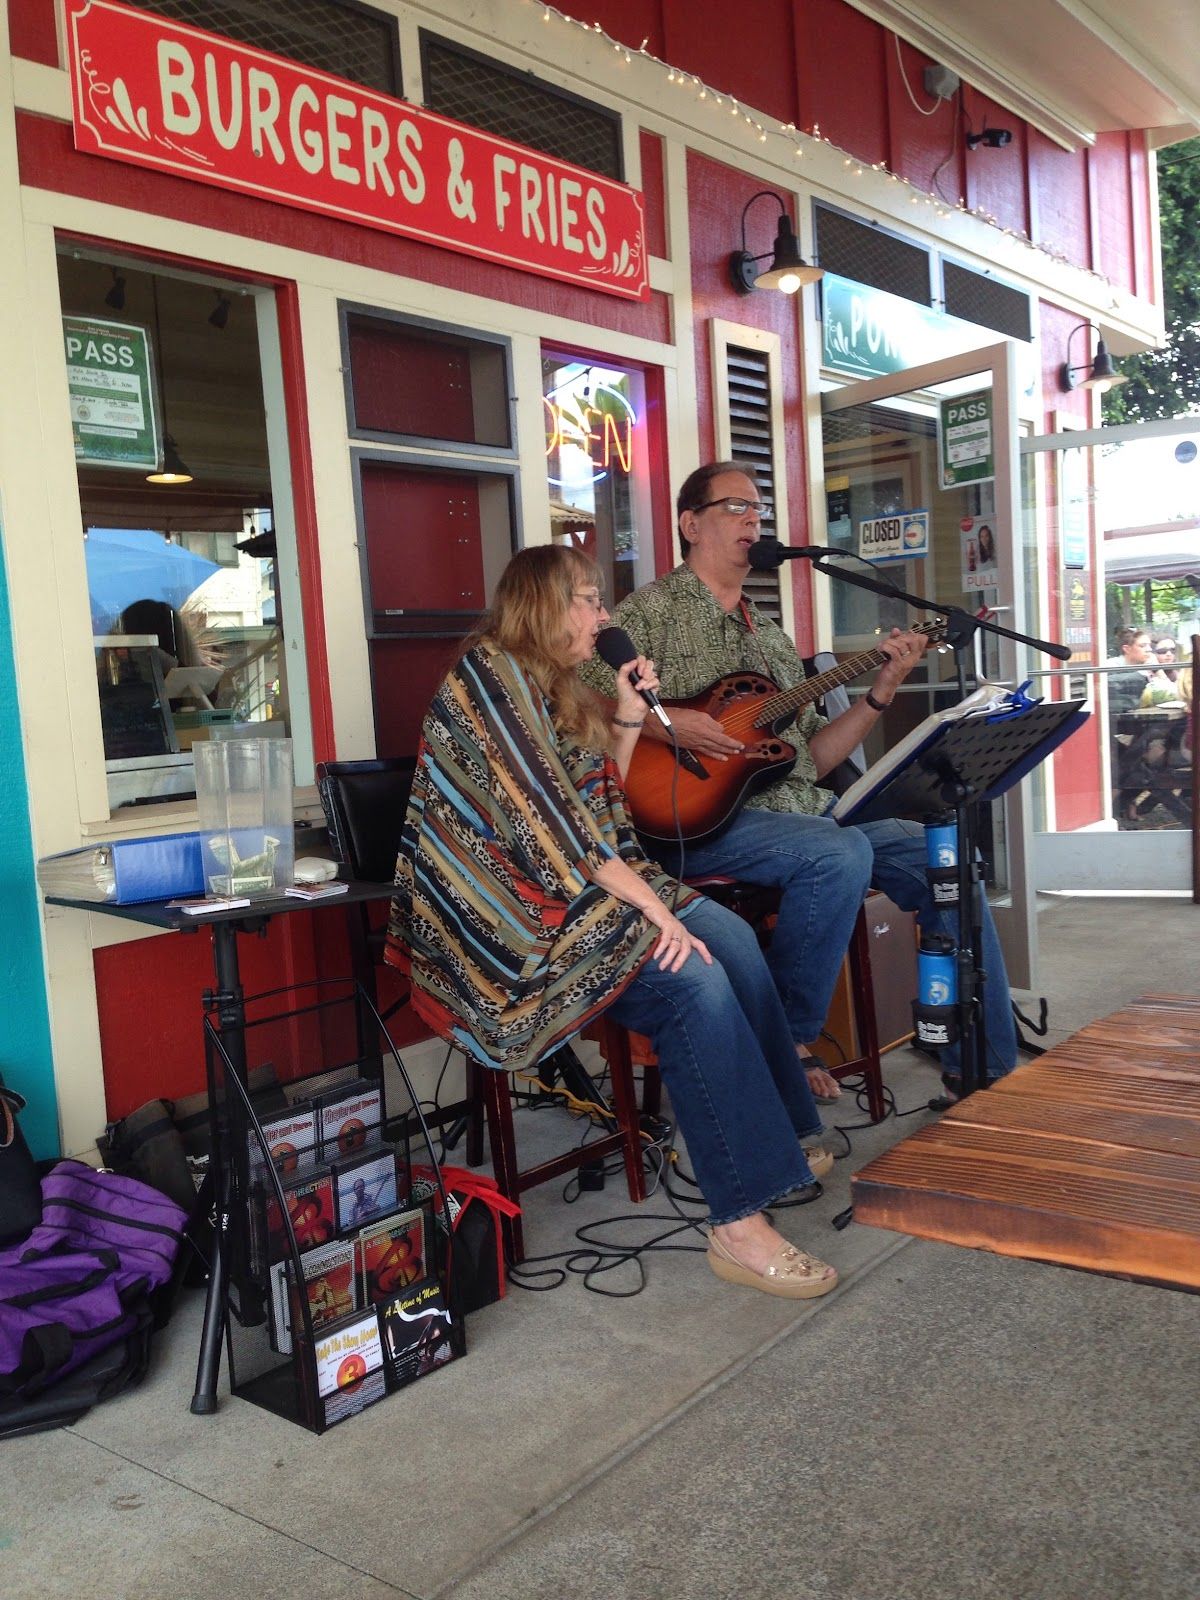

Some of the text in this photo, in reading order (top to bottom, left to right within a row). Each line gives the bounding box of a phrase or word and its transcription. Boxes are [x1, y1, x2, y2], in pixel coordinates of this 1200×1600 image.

[156, 39, 607, 261] BURGERS & FRIES
[66, 336, 135, 368] PASS
[947, 401, 987, 424] PASS
[862, 518, 900, 545] CLOSED
[967, 574, 998, 587] PULL
[422, 1286, 441, 1299] Music
